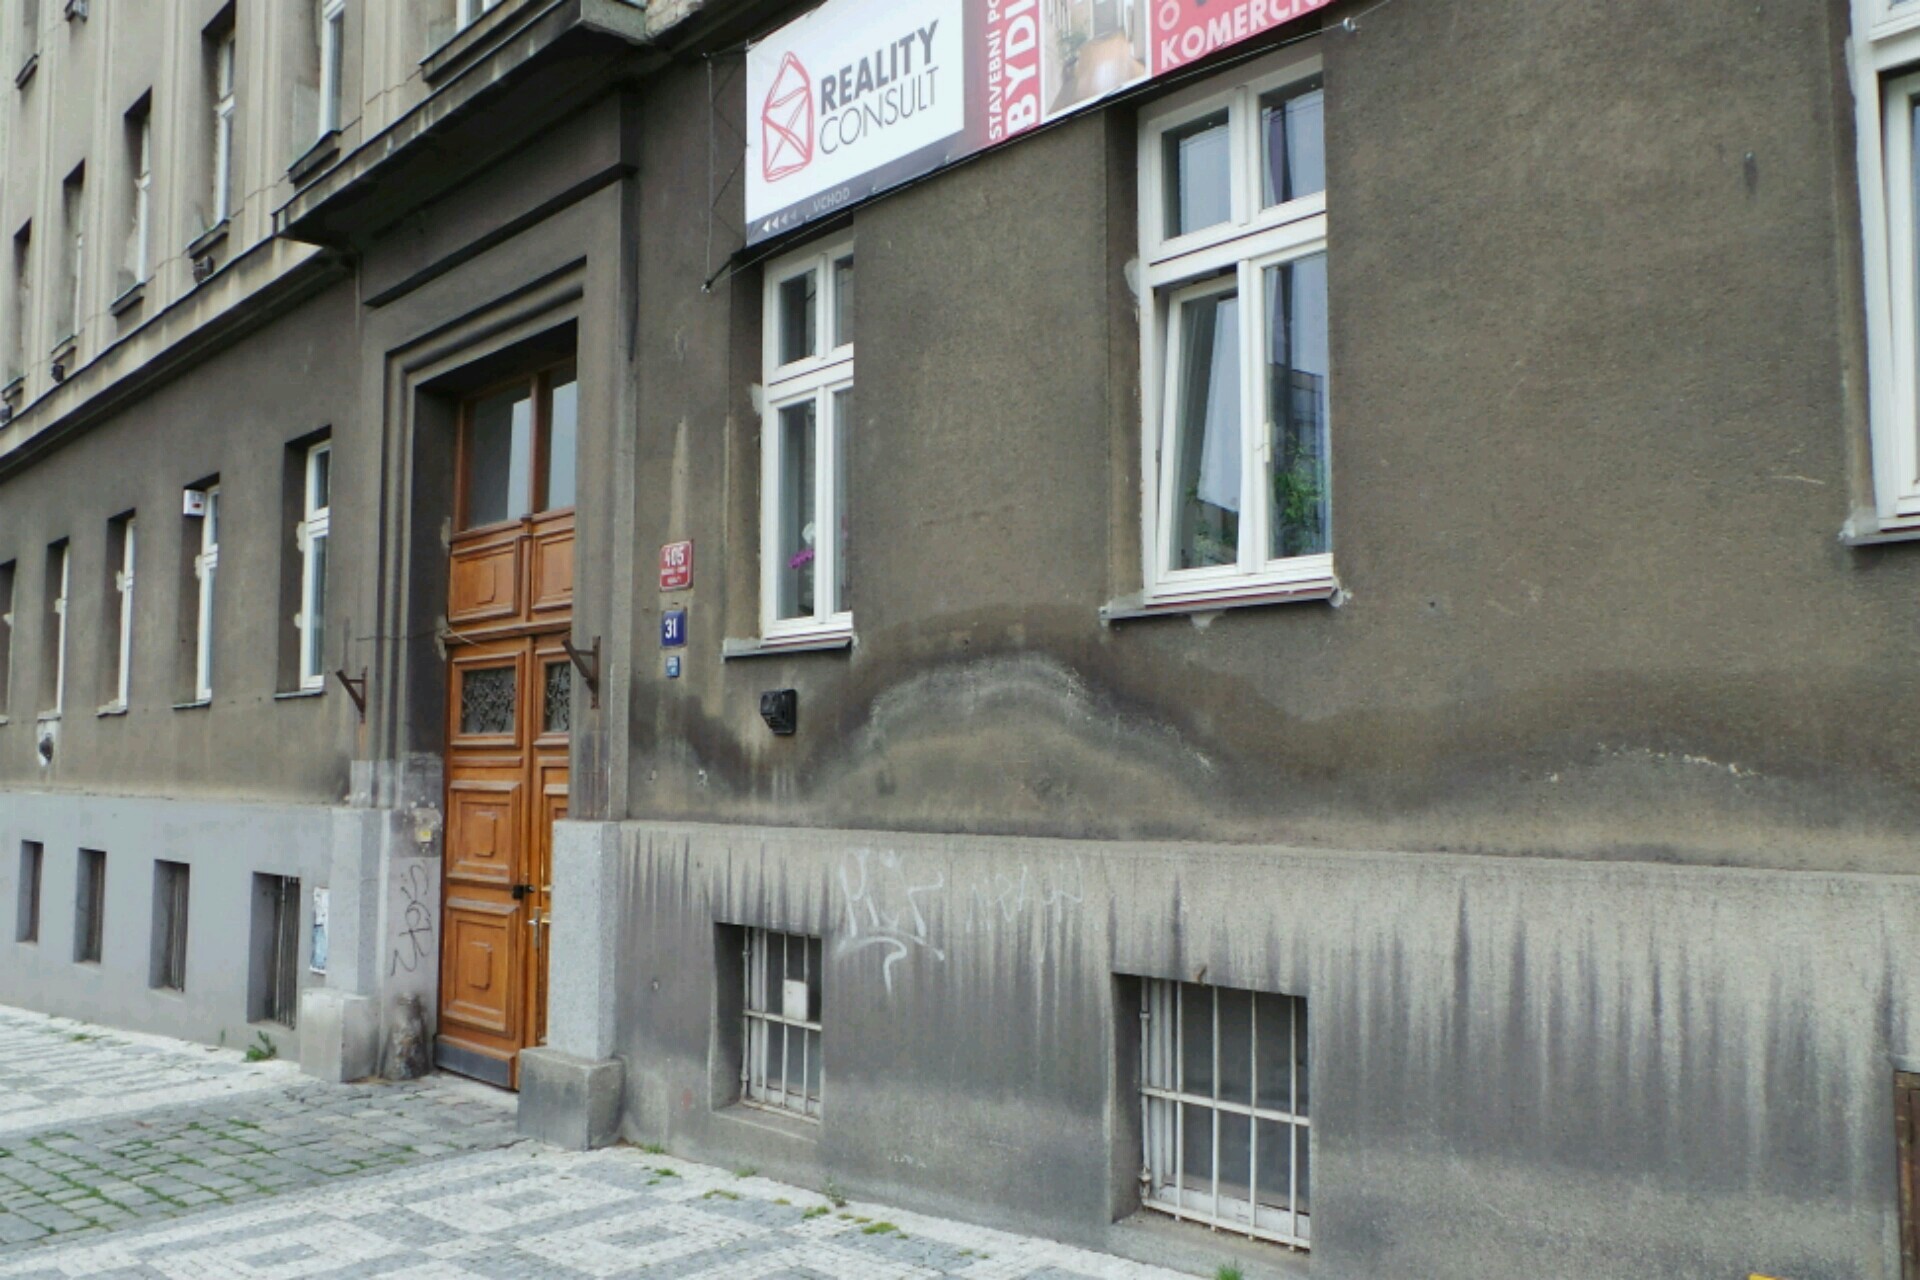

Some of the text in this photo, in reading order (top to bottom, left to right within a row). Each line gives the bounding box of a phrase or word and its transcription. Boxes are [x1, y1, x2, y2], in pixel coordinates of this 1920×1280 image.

[819, 66, 939, 155] CONSULT
[821, 19, 939, 116] REALITY
[985, 29, 1002, 140] STAVEBNÍ
[813, 187, 850, 212] VCHOD
[664, 617, 678, 640] 31
